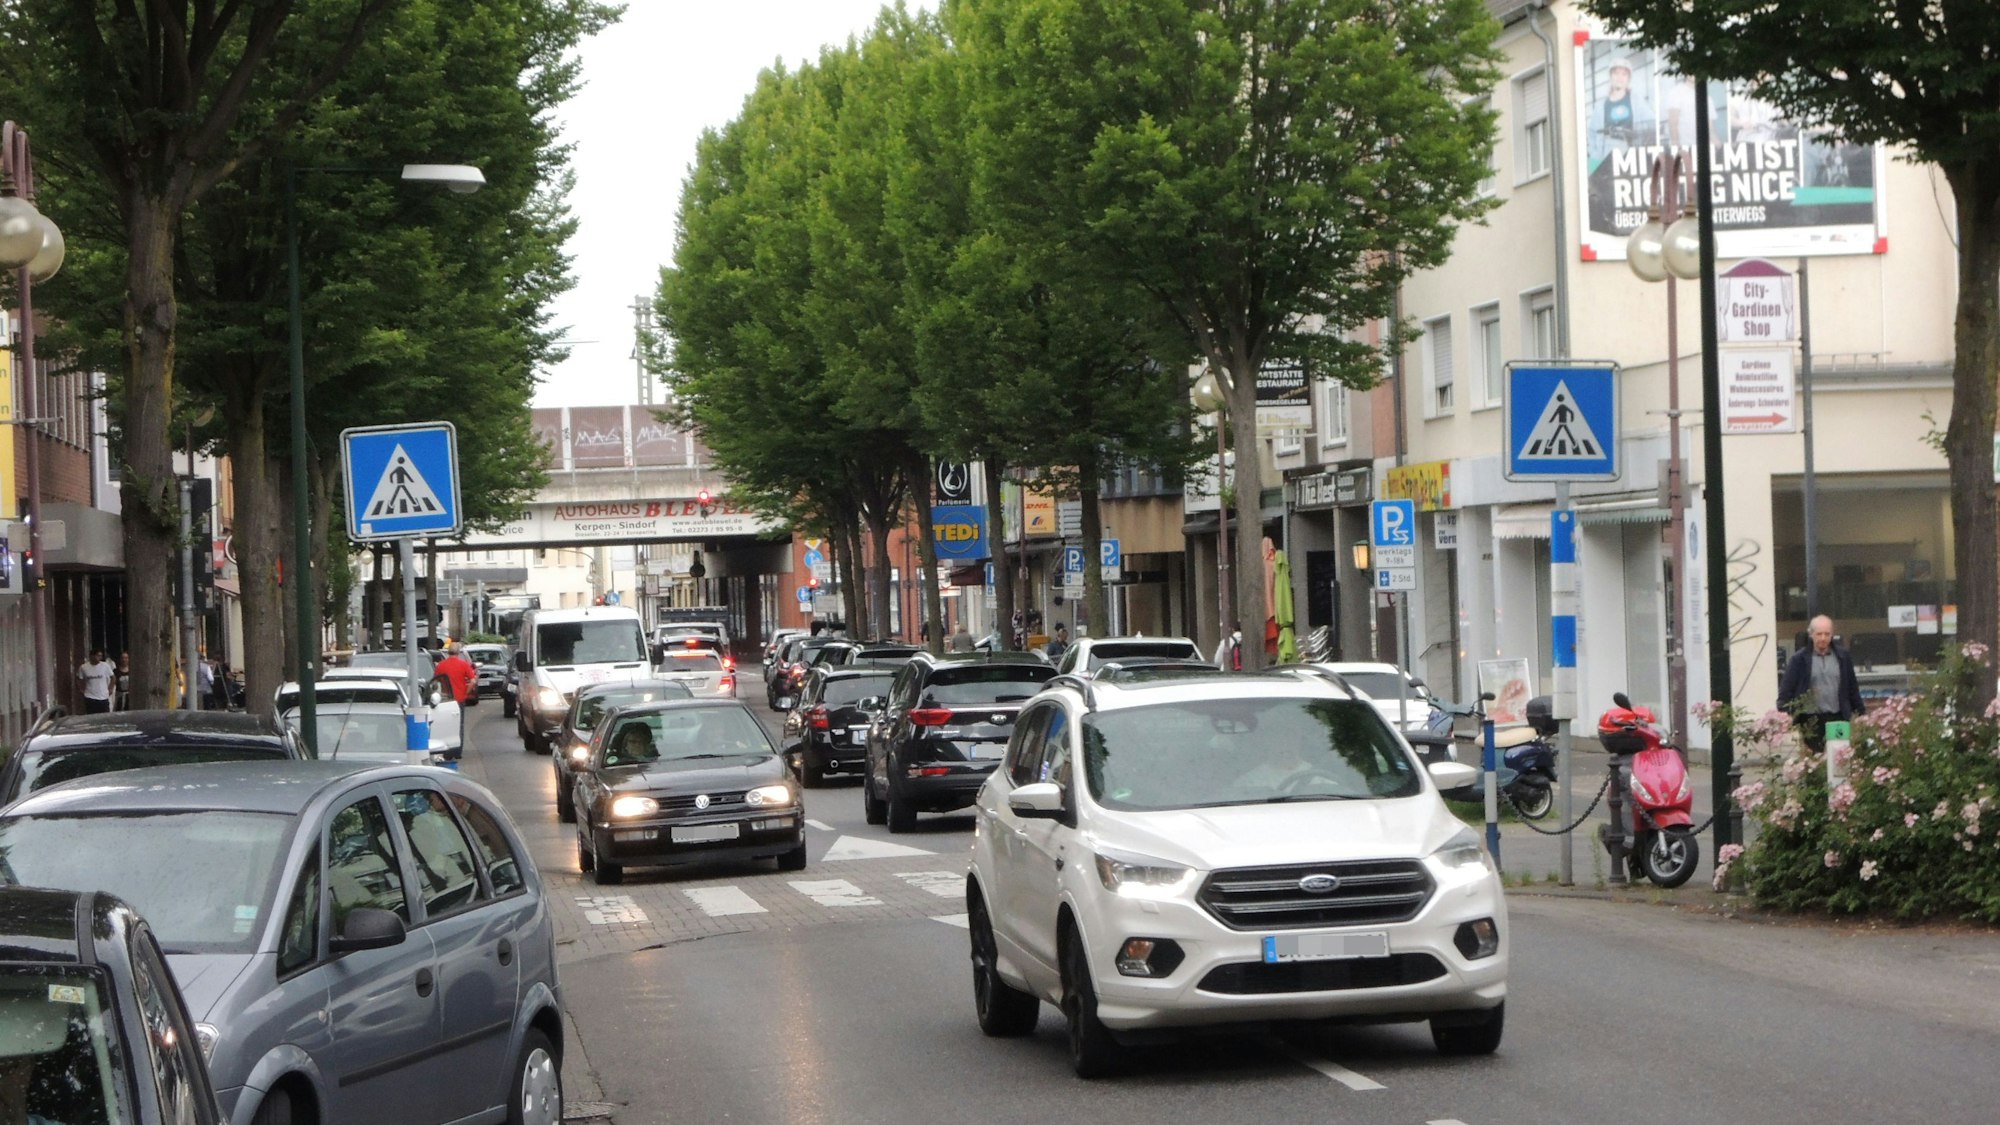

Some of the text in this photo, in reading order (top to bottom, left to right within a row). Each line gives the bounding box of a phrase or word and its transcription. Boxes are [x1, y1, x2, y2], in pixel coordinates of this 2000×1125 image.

[1612, 146, 1664, 176] MIT
[1754, 140, 1796, 170] IST
[1614, 171, 1796, 207] RICTG NICE
[1712, 205, 1766, 224] NTERWEGS
[1744, 282, 1769, 299] City-
[1732, 303, 1782, 318] Gardinen
[1744, 321, 1771, 337] Shop
[1741, 361, 1771, 369] Gardinen
[1258, 370, 1304, 379] ATSTÄTTE
[1256, 379, 1304, 388] ESTAURANT
[1301, 478, 1316, 506] The
[1317, 475, 1335, 504] Best
[554, 503, 641, 521] AUTOHAUS
[575, 523, 611, 531] Kerpen
[619, 520, 656, 530] Sindorf
[1381, 506, 1404, 541] P
[932, 524, 979, 541] TEDi
[1377, 549, 1412, 557] werktags
